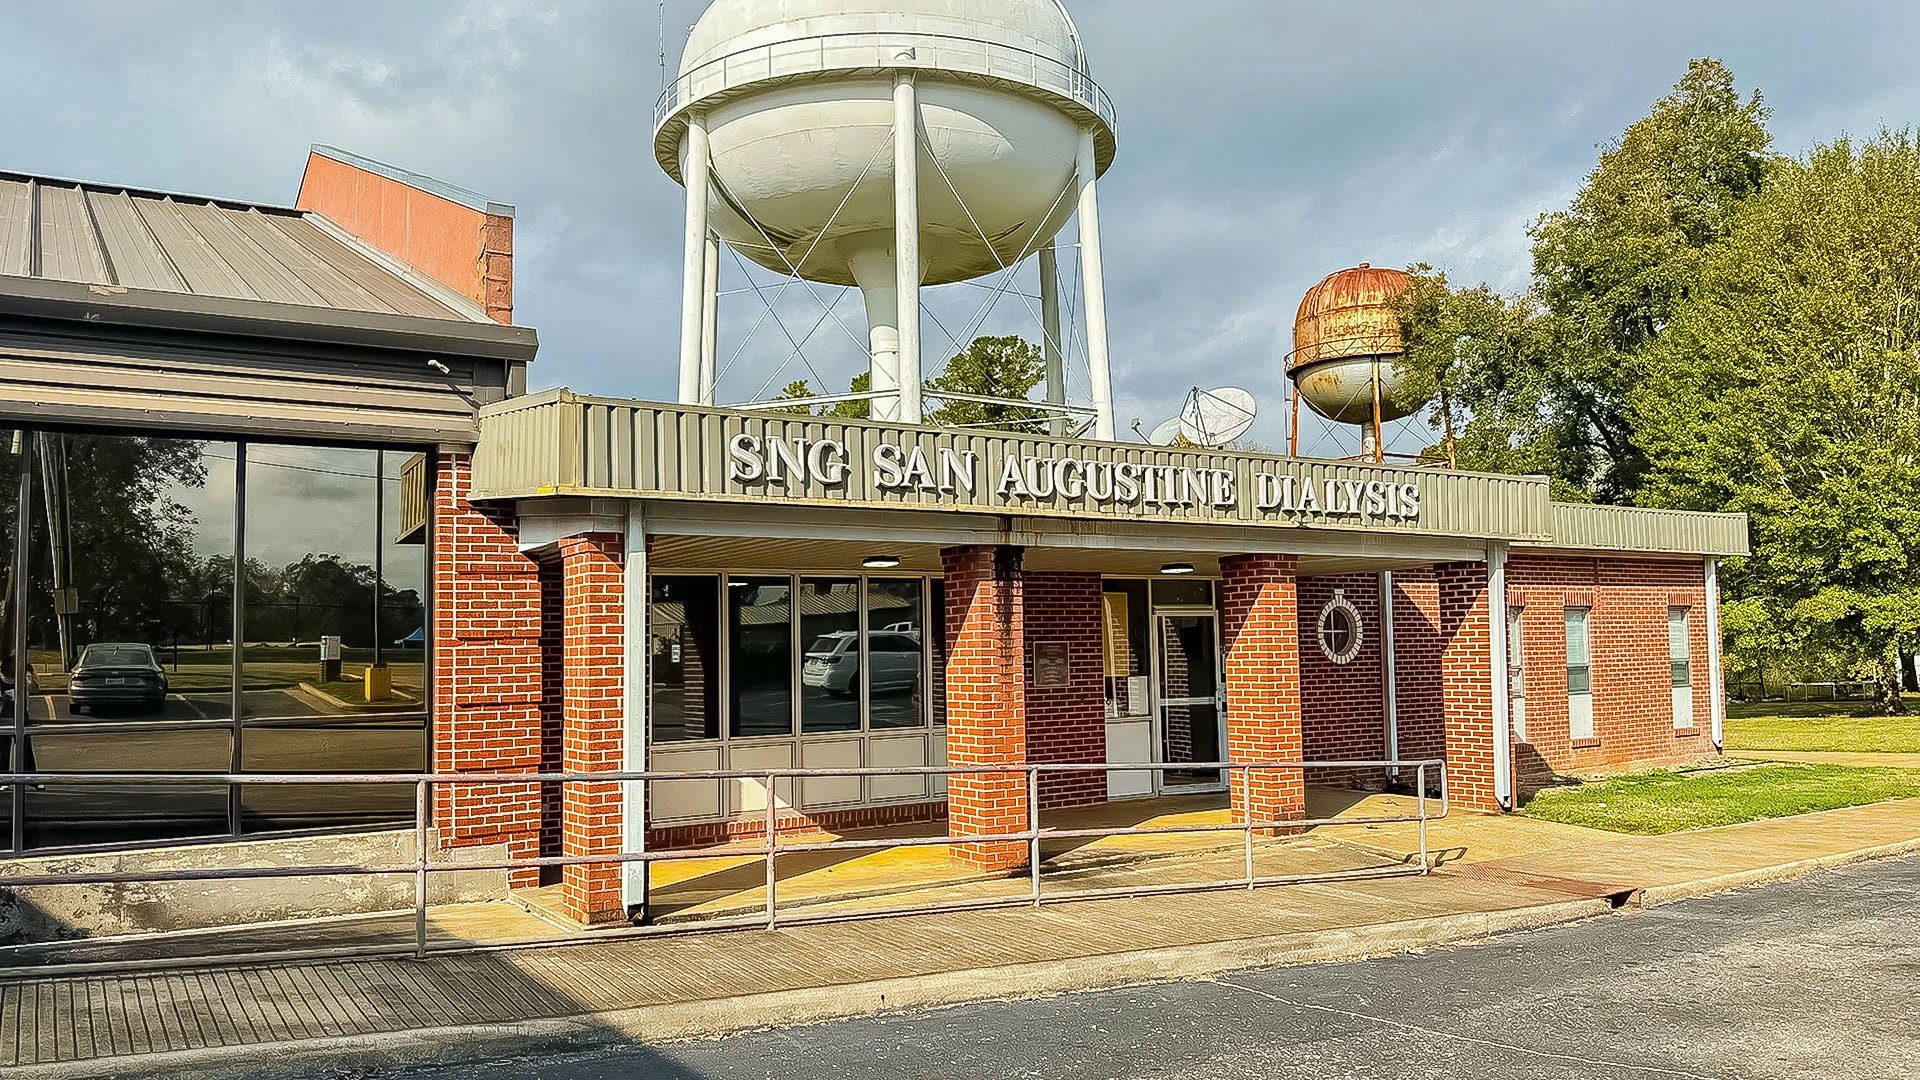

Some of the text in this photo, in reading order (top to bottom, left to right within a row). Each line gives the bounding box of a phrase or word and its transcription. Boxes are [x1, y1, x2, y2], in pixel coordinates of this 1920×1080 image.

[730, 433, 1420, 517] SNG SAN AUGUSTINE DIALYSIS
